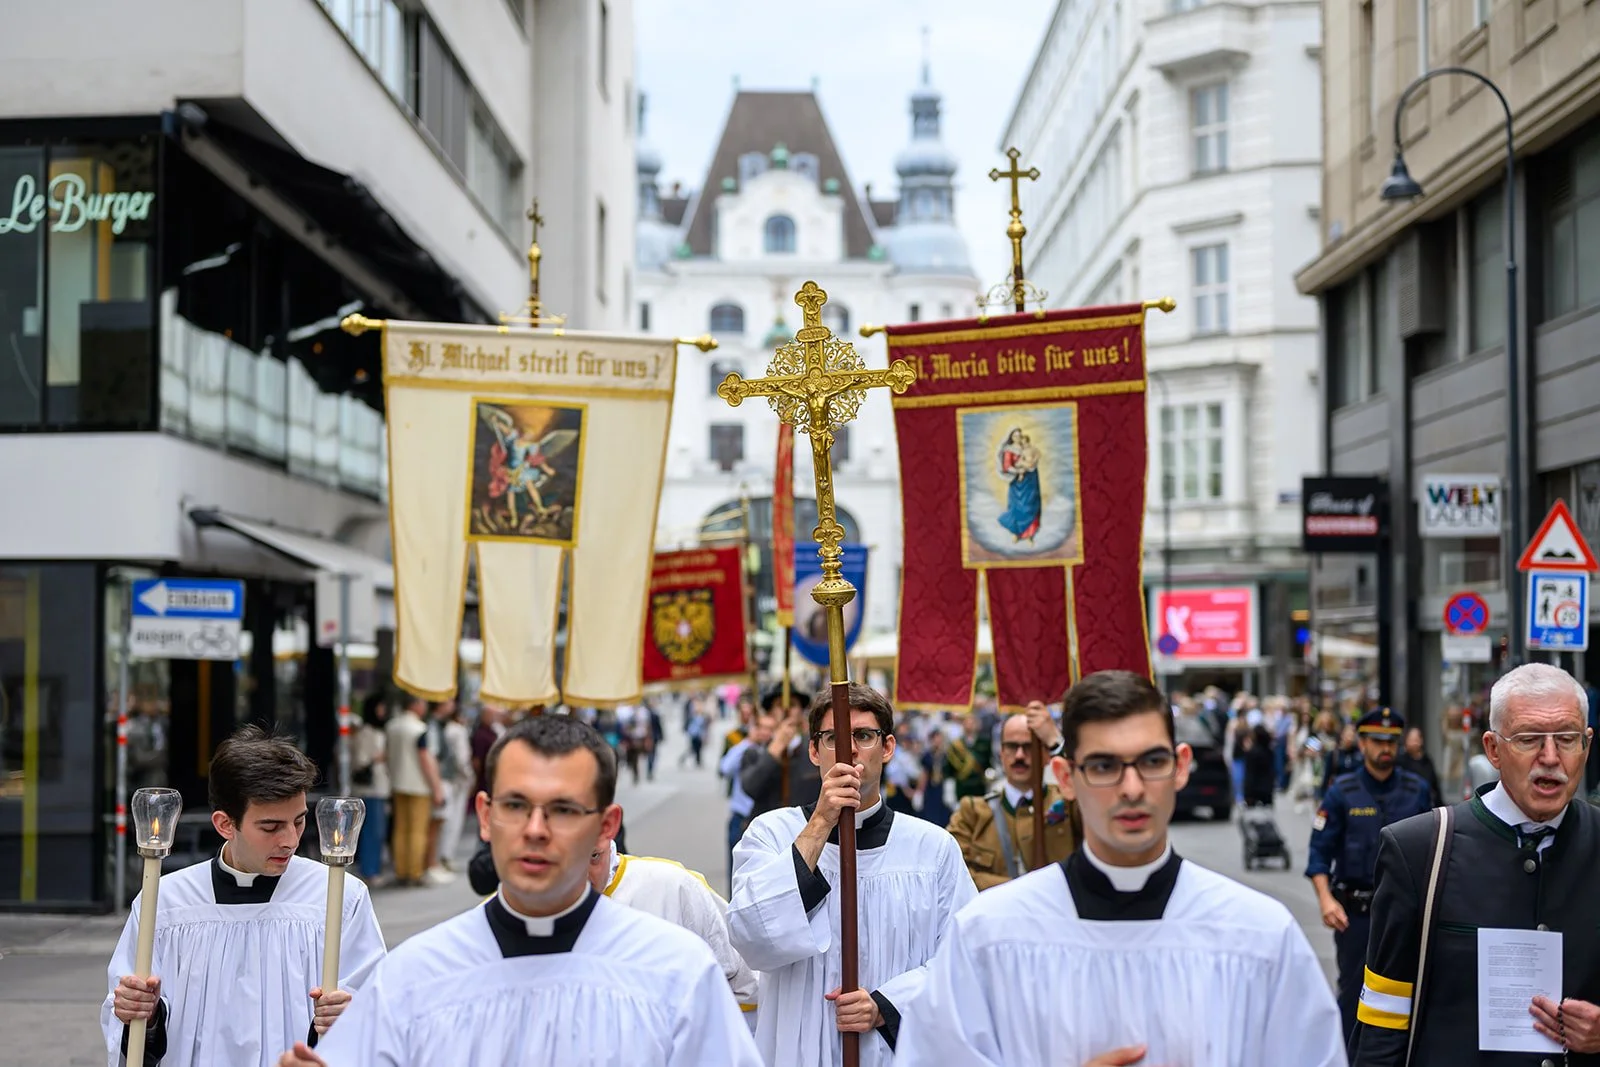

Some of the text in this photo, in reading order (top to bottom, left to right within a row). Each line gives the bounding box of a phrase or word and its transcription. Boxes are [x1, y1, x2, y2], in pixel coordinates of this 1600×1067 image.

[0, 173, 155, 234] Le Burger
[441, 343, 511, 375] Michael
[519, 348, 569, 376] streit
[576, 351, 604, 378] für
[929, 352, 990, 382] Maria
[996, 349, 1036, 374] bitte
[1043, 344, 1075, 373] für
[1427, 484, 1498, 507] WELT
[167, 589, 229, 607] EINBAHN
